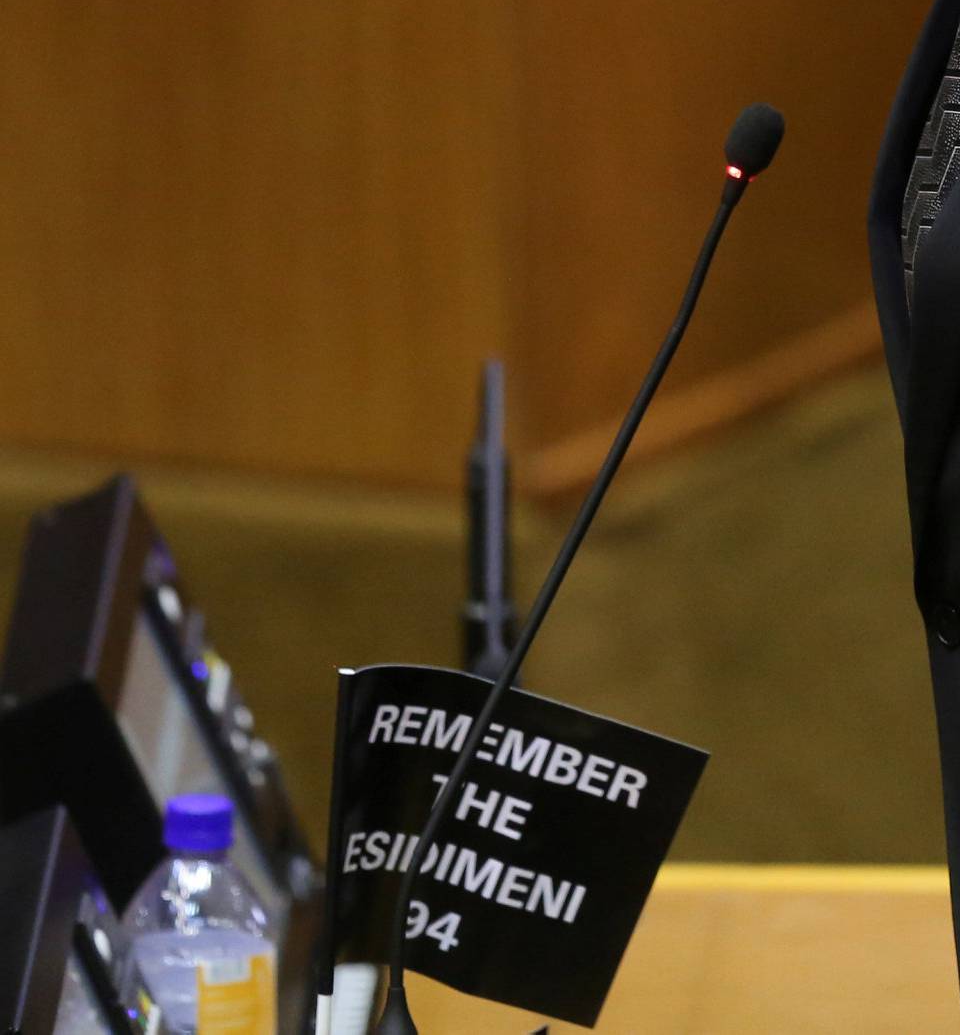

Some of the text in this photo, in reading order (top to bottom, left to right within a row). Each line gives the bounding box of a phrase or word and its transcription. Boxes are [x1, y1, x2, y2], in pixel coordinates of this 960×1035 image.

[369, 704, 648, 809] REMEMBER
[342, 830, 587, 924] ESIDIMENI
[404, 899, 462, 952] 94
